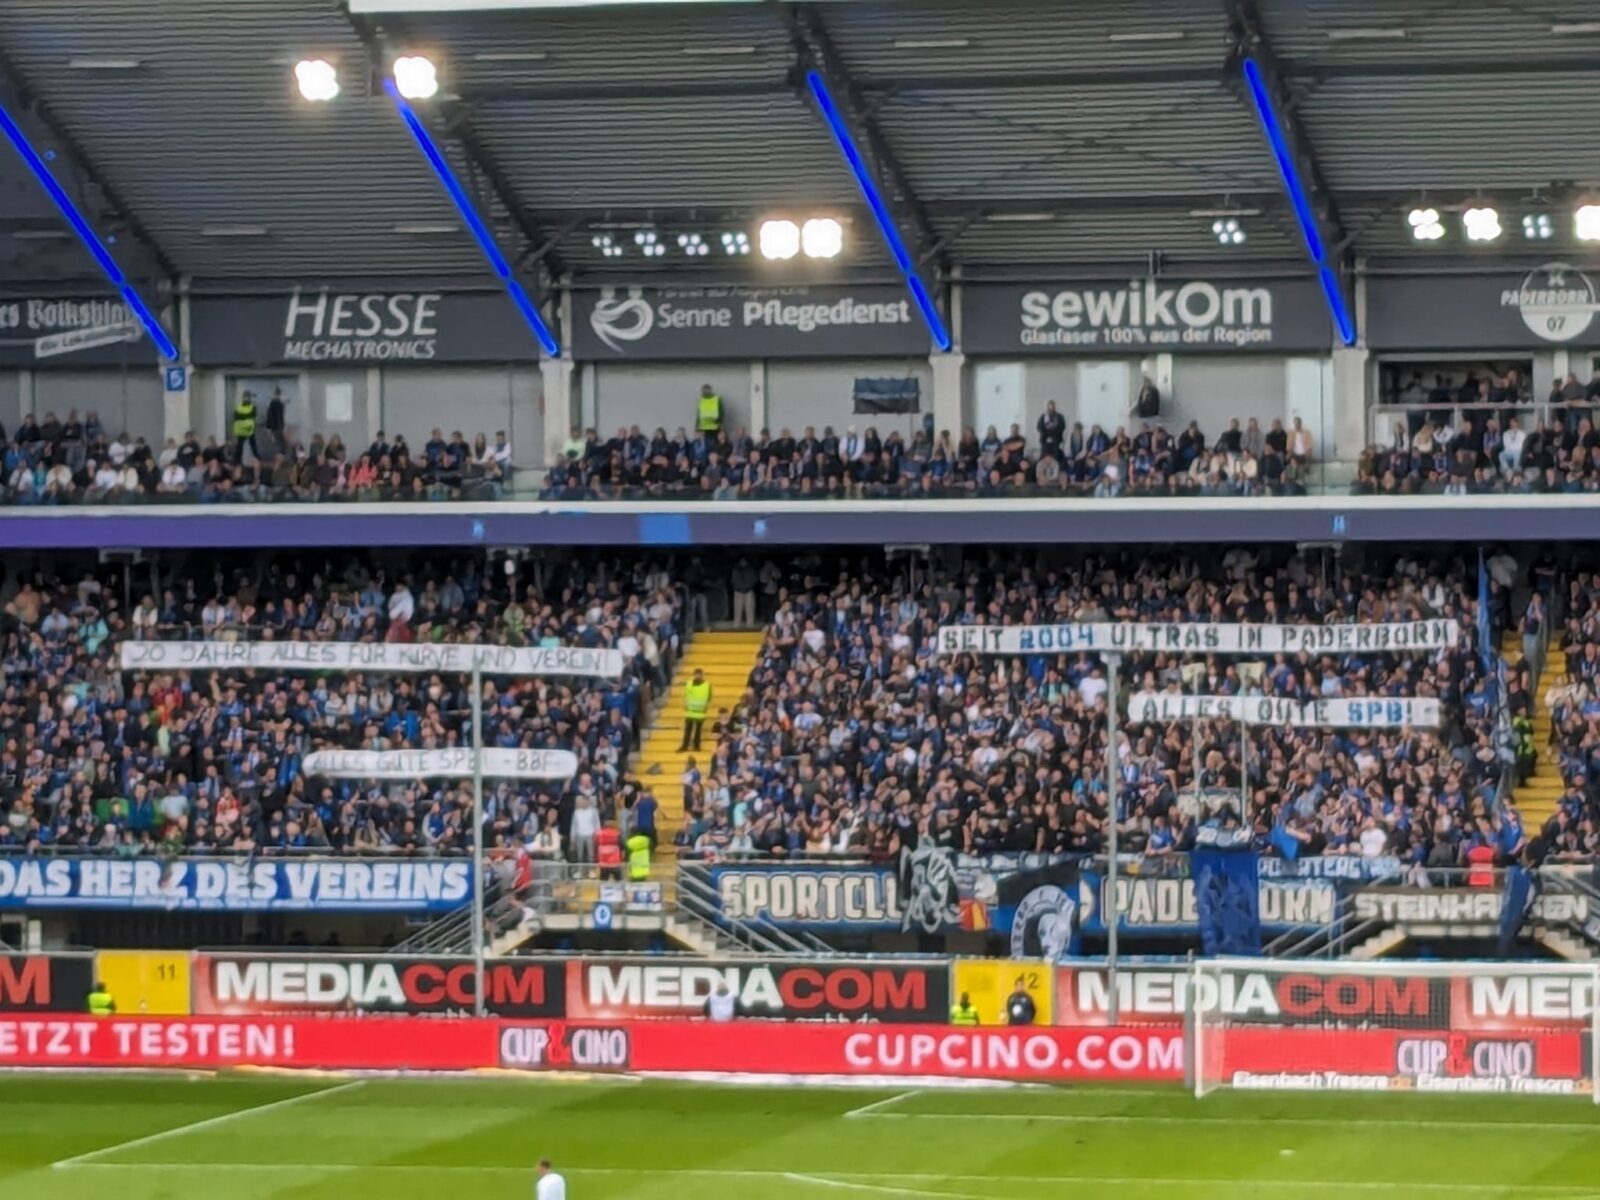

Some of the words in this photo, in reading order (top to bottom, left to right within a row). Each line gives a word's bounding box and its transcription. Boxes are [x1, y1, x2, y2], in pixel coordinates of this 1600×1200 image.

[285, 288, 440, 338] HESSE
[658, 303, 731, 328] Senne
[743, 297, 910, 331] Pflegedienst
[1546, 315, 1566, 332] 07
[284, 339, 437, 360] MECHATRONICS
[1020, 328, 1098, 345] Glasfaser
[1103, 329, 1146, 344] 100%
[1149, 331, 1180, 343] aus
[1182, 328, 1209, 343] der
[1214, 327, 1272, 346] Region
[943, 626, 1003, 651] SEIT
[1020, 623, 1094, 648] 2004
[1110, 623, 1219, 648] ULTRAS
[1238, 625, 1262, 648] IN
[1281, 620, 1450, 649] PADERBORN
[270, 642, 338, 664] ALLES
[0, 860, 72, 896] DAS
[79, 861, 188, 899] HERZ
[195, 863, 278, 900] DES
[284, 863, 469, 900] VEREINS
[157, 964, 176, 981] 11
[216, 960, 545, 1005] MEDIACOM
[589, 964, 926, 1010] MEDIACOM
[1078, 970, 1430, 1016] MEDIACOM
[112, 1024, 296, 1056] TESTEN!
[844, 1033, 1183, 1072] CUPCINO.COM
